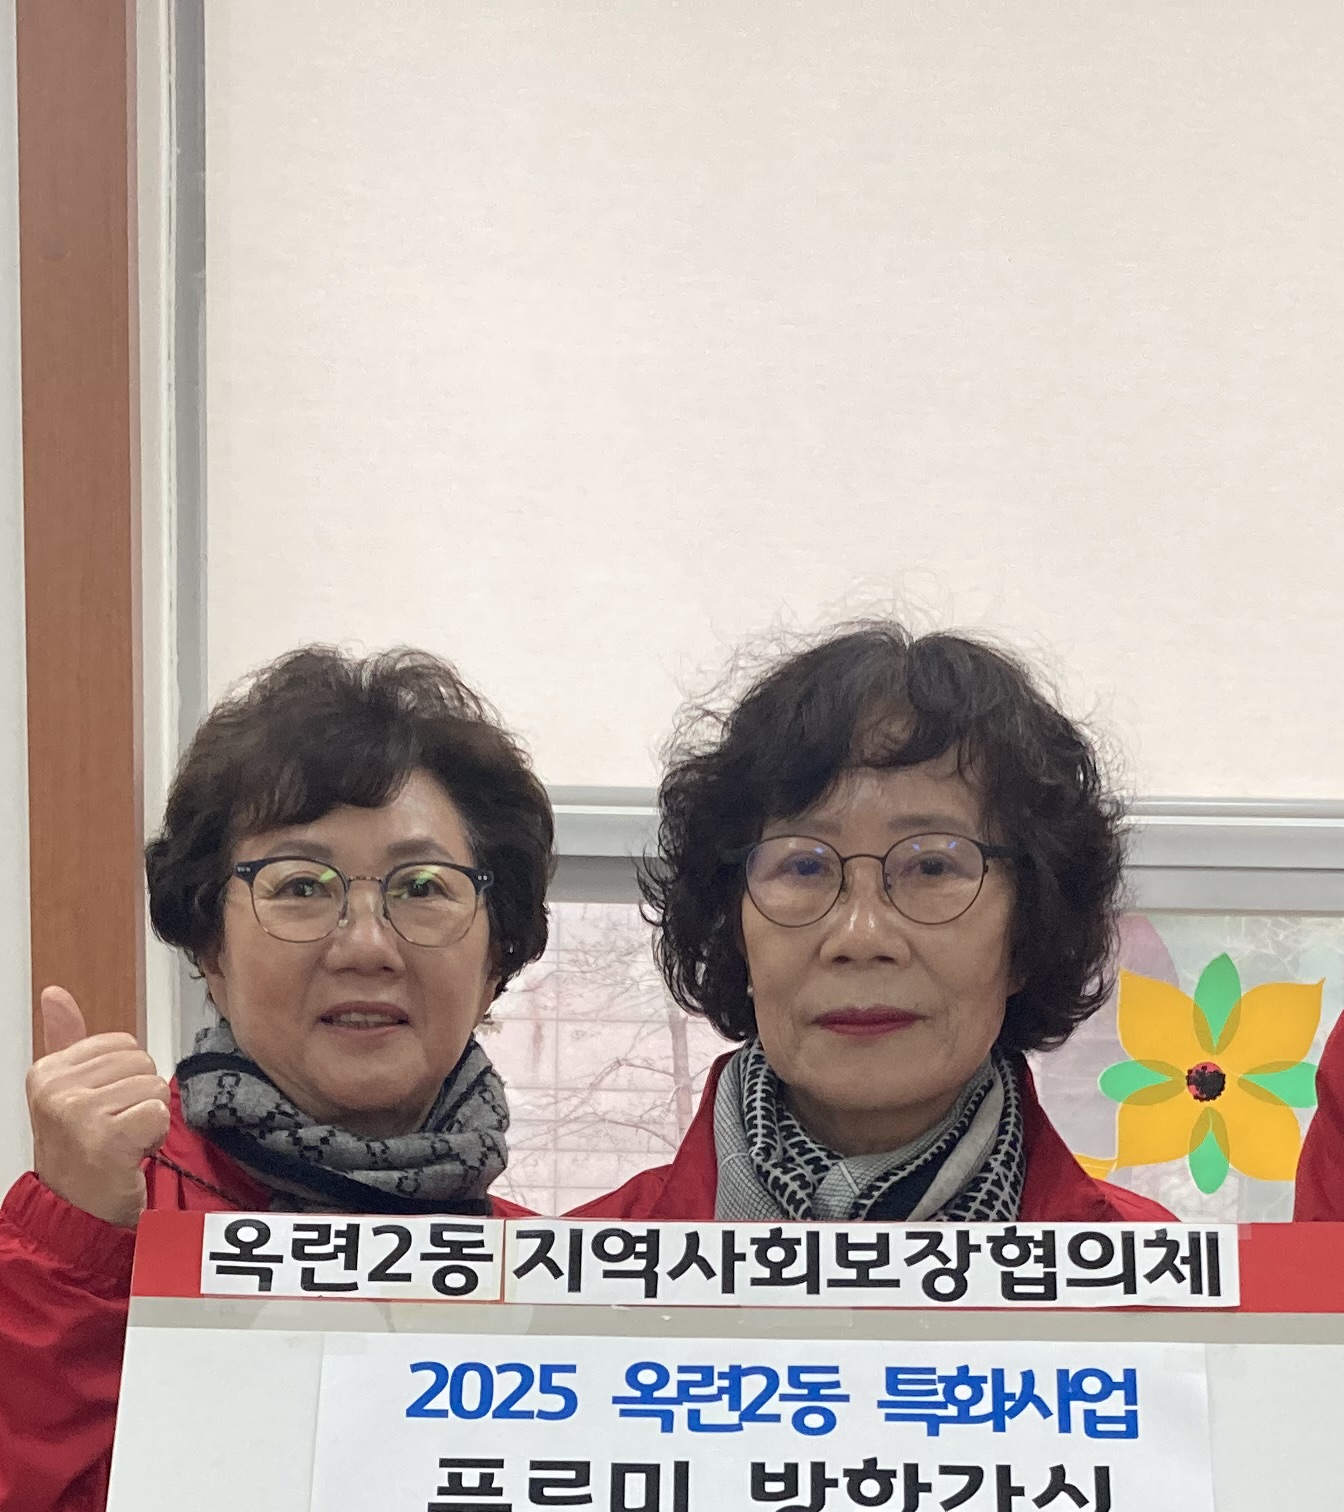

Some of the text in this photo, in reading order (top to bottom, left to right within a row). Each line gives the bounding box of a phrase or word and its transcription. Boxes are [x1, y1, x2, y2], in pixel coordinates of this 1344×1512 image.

[209, 1218, 1221, 1301] 옥련2동 지역사회보장협의체
[405, 1361, 1140, 1439] 2025 옥련2동 특화사업
